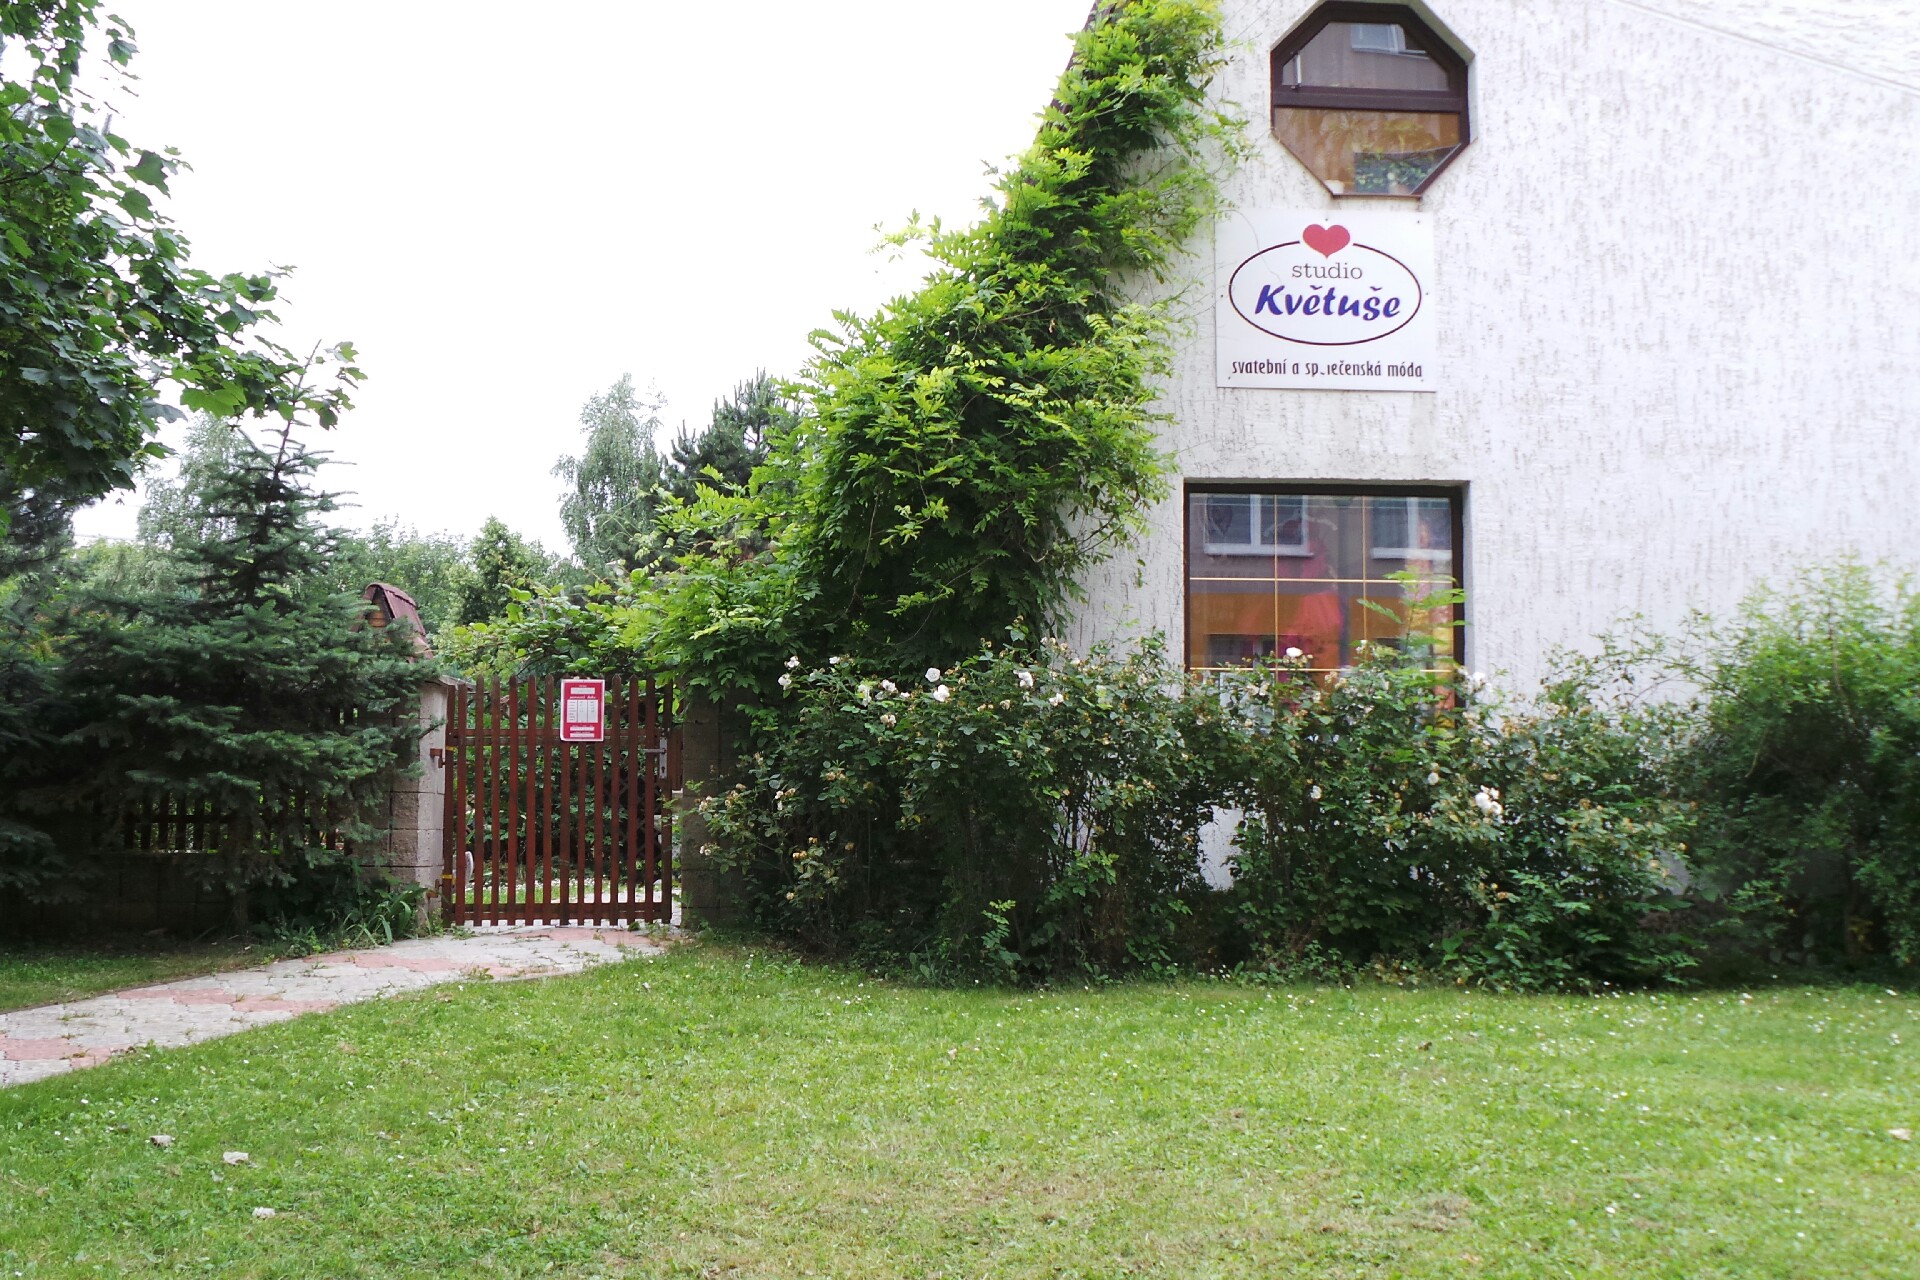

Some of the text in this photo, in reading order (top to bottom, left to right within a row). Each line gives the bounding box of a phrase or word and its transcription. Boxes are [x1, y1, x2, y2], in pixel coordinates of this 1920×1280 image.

[1291, 262, 1363, 280] studio
[1254, 284, 1401, 321] Květuše
[1232, 358, 1423, 378] svatební a splečenská móda
